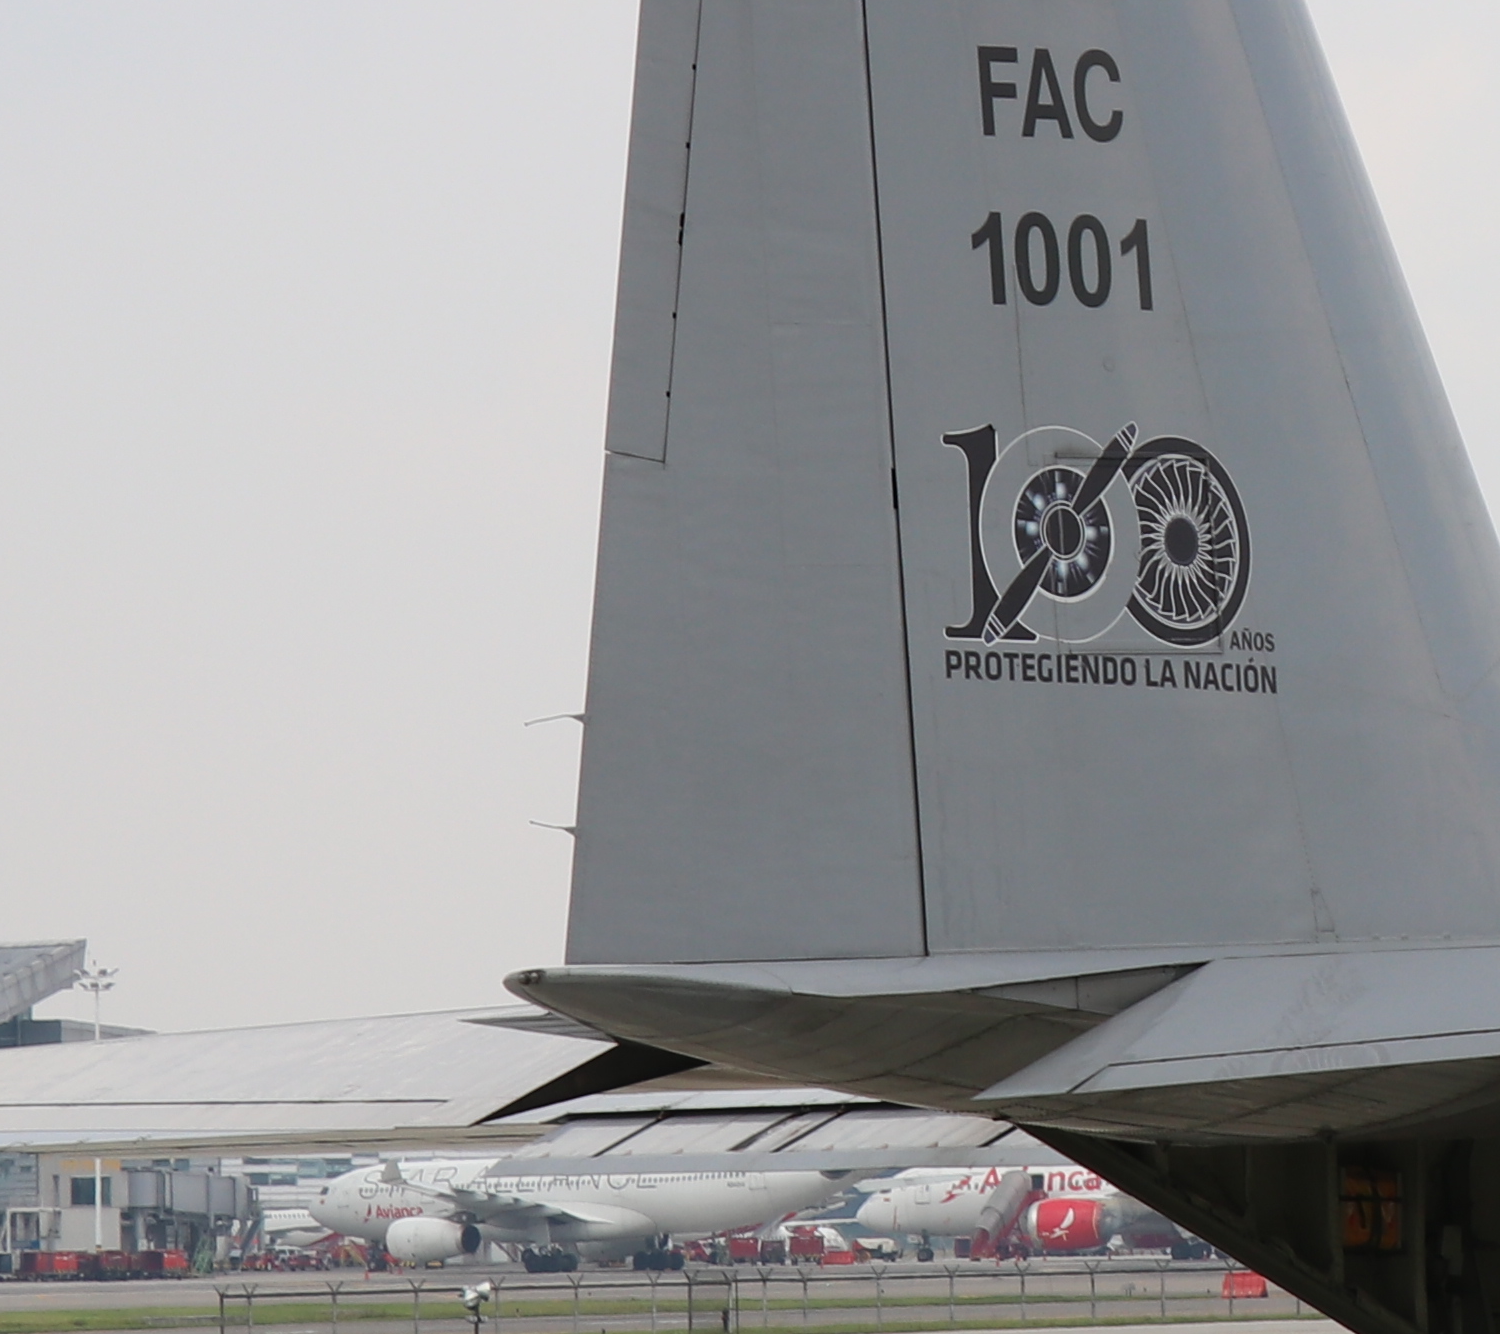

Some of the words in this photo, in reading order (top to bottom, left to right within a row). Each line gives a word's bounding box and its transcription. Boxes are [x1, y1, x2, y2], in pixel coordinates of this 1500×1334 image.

[976, 45, 1124, 143] FAC
[970, 210, 1154, 312] 1001
[944, 649, 1138, 687] PROTEGIENDO
[1144, 659, 1178, 688] LA
[1184, 657, 1278, 695] NACIÓN
[1229, 627, 1276, 653] AÑOS
